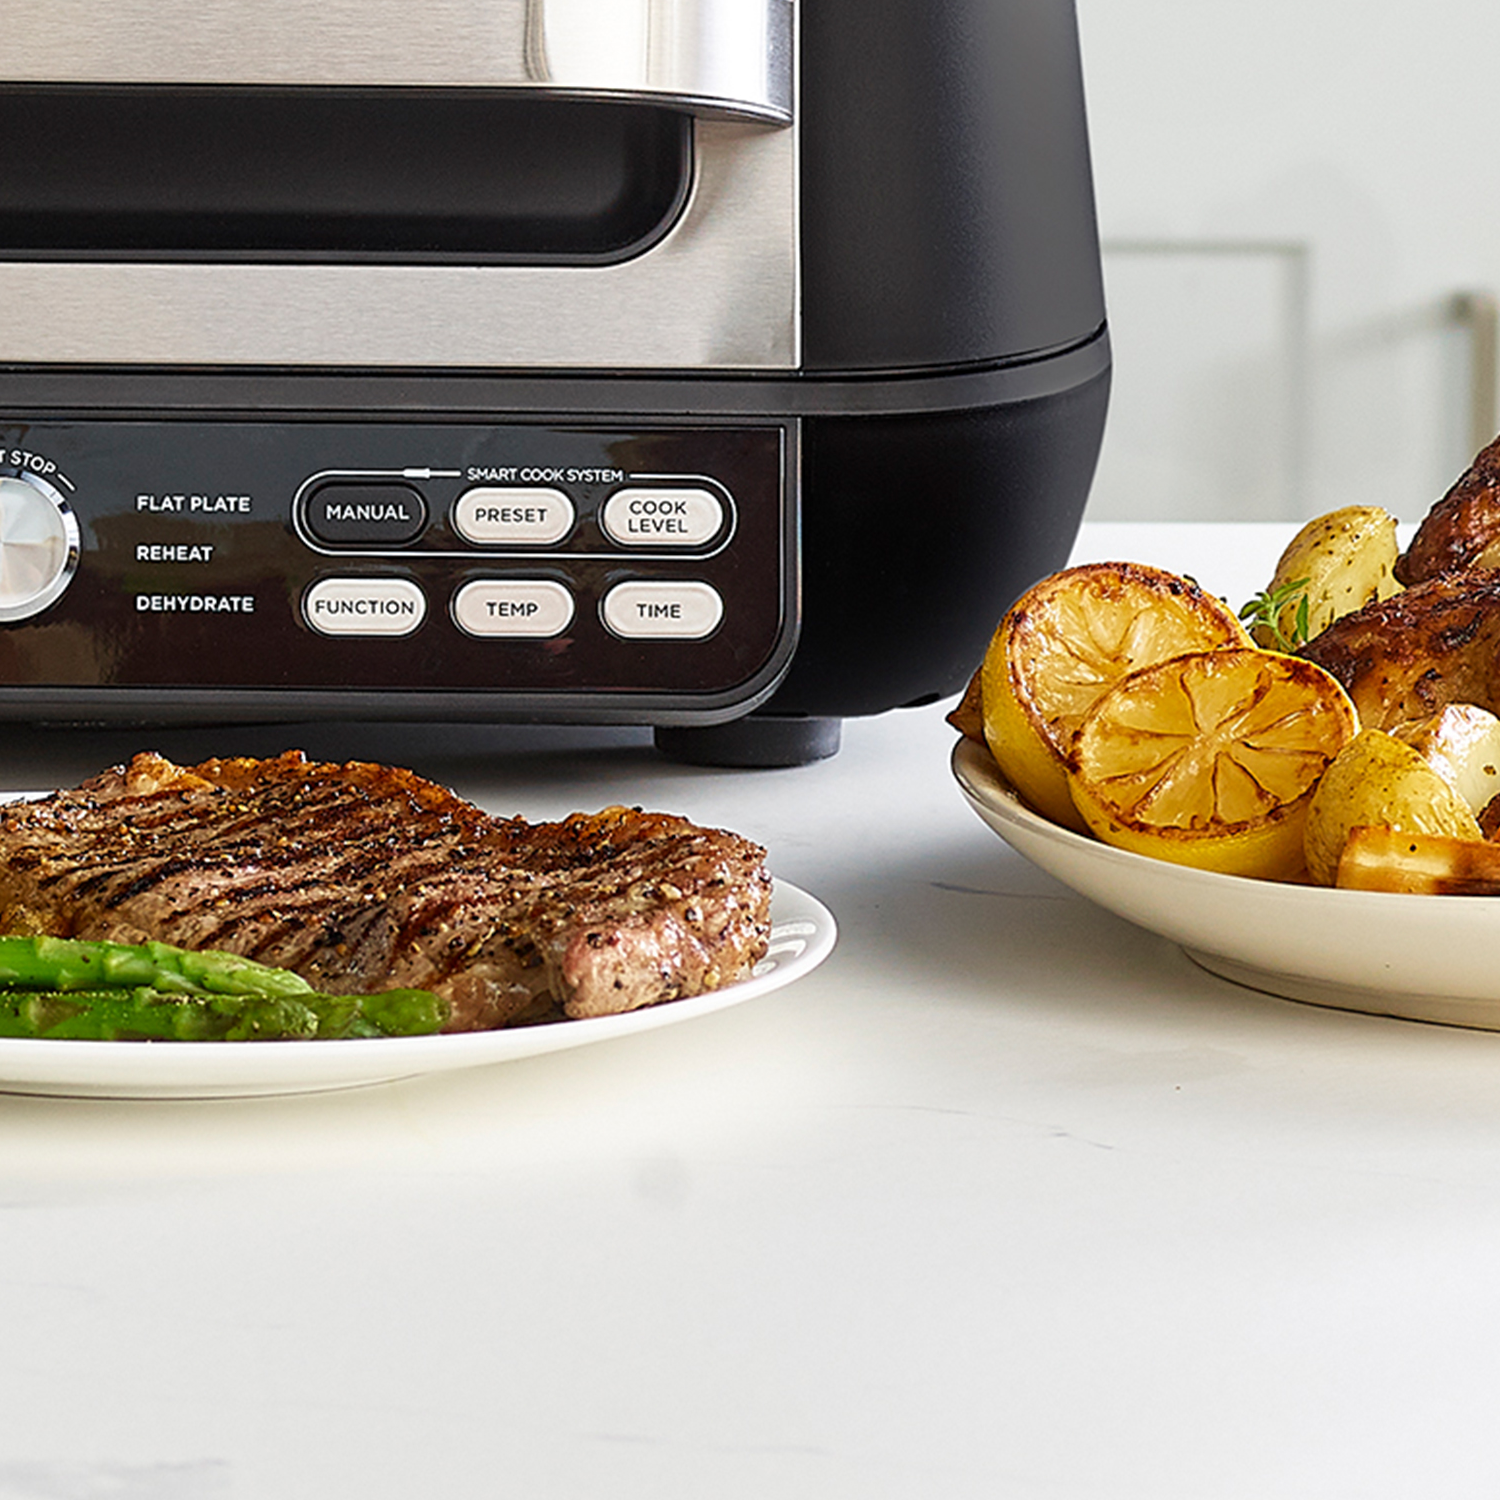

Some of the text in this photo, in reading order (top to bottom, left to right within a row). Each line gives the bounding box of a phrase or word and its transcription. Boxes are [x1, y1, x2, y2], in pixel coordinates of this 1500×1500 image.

[10, 450, 57, 476] STOP
[467, 468, 624, 482] SMART COOK SYSTEM
[136, 496, 252, 513] FLAT PLATE
[629, 500, 687, 516] COOK
[325, 505, 410, 521] MANUAL
[476, 508, 548, 523] PRESET
[628, 518, 689, 534] LEVEL
[136, 546, 213, 561] REHEAT
[136, 596, 254, 612] DEHYDRATE
[315, 599, 415, 615] FUNCTION
[486, 602, 538, 617] TEMP
[636, 603, 681, 619] TIME
